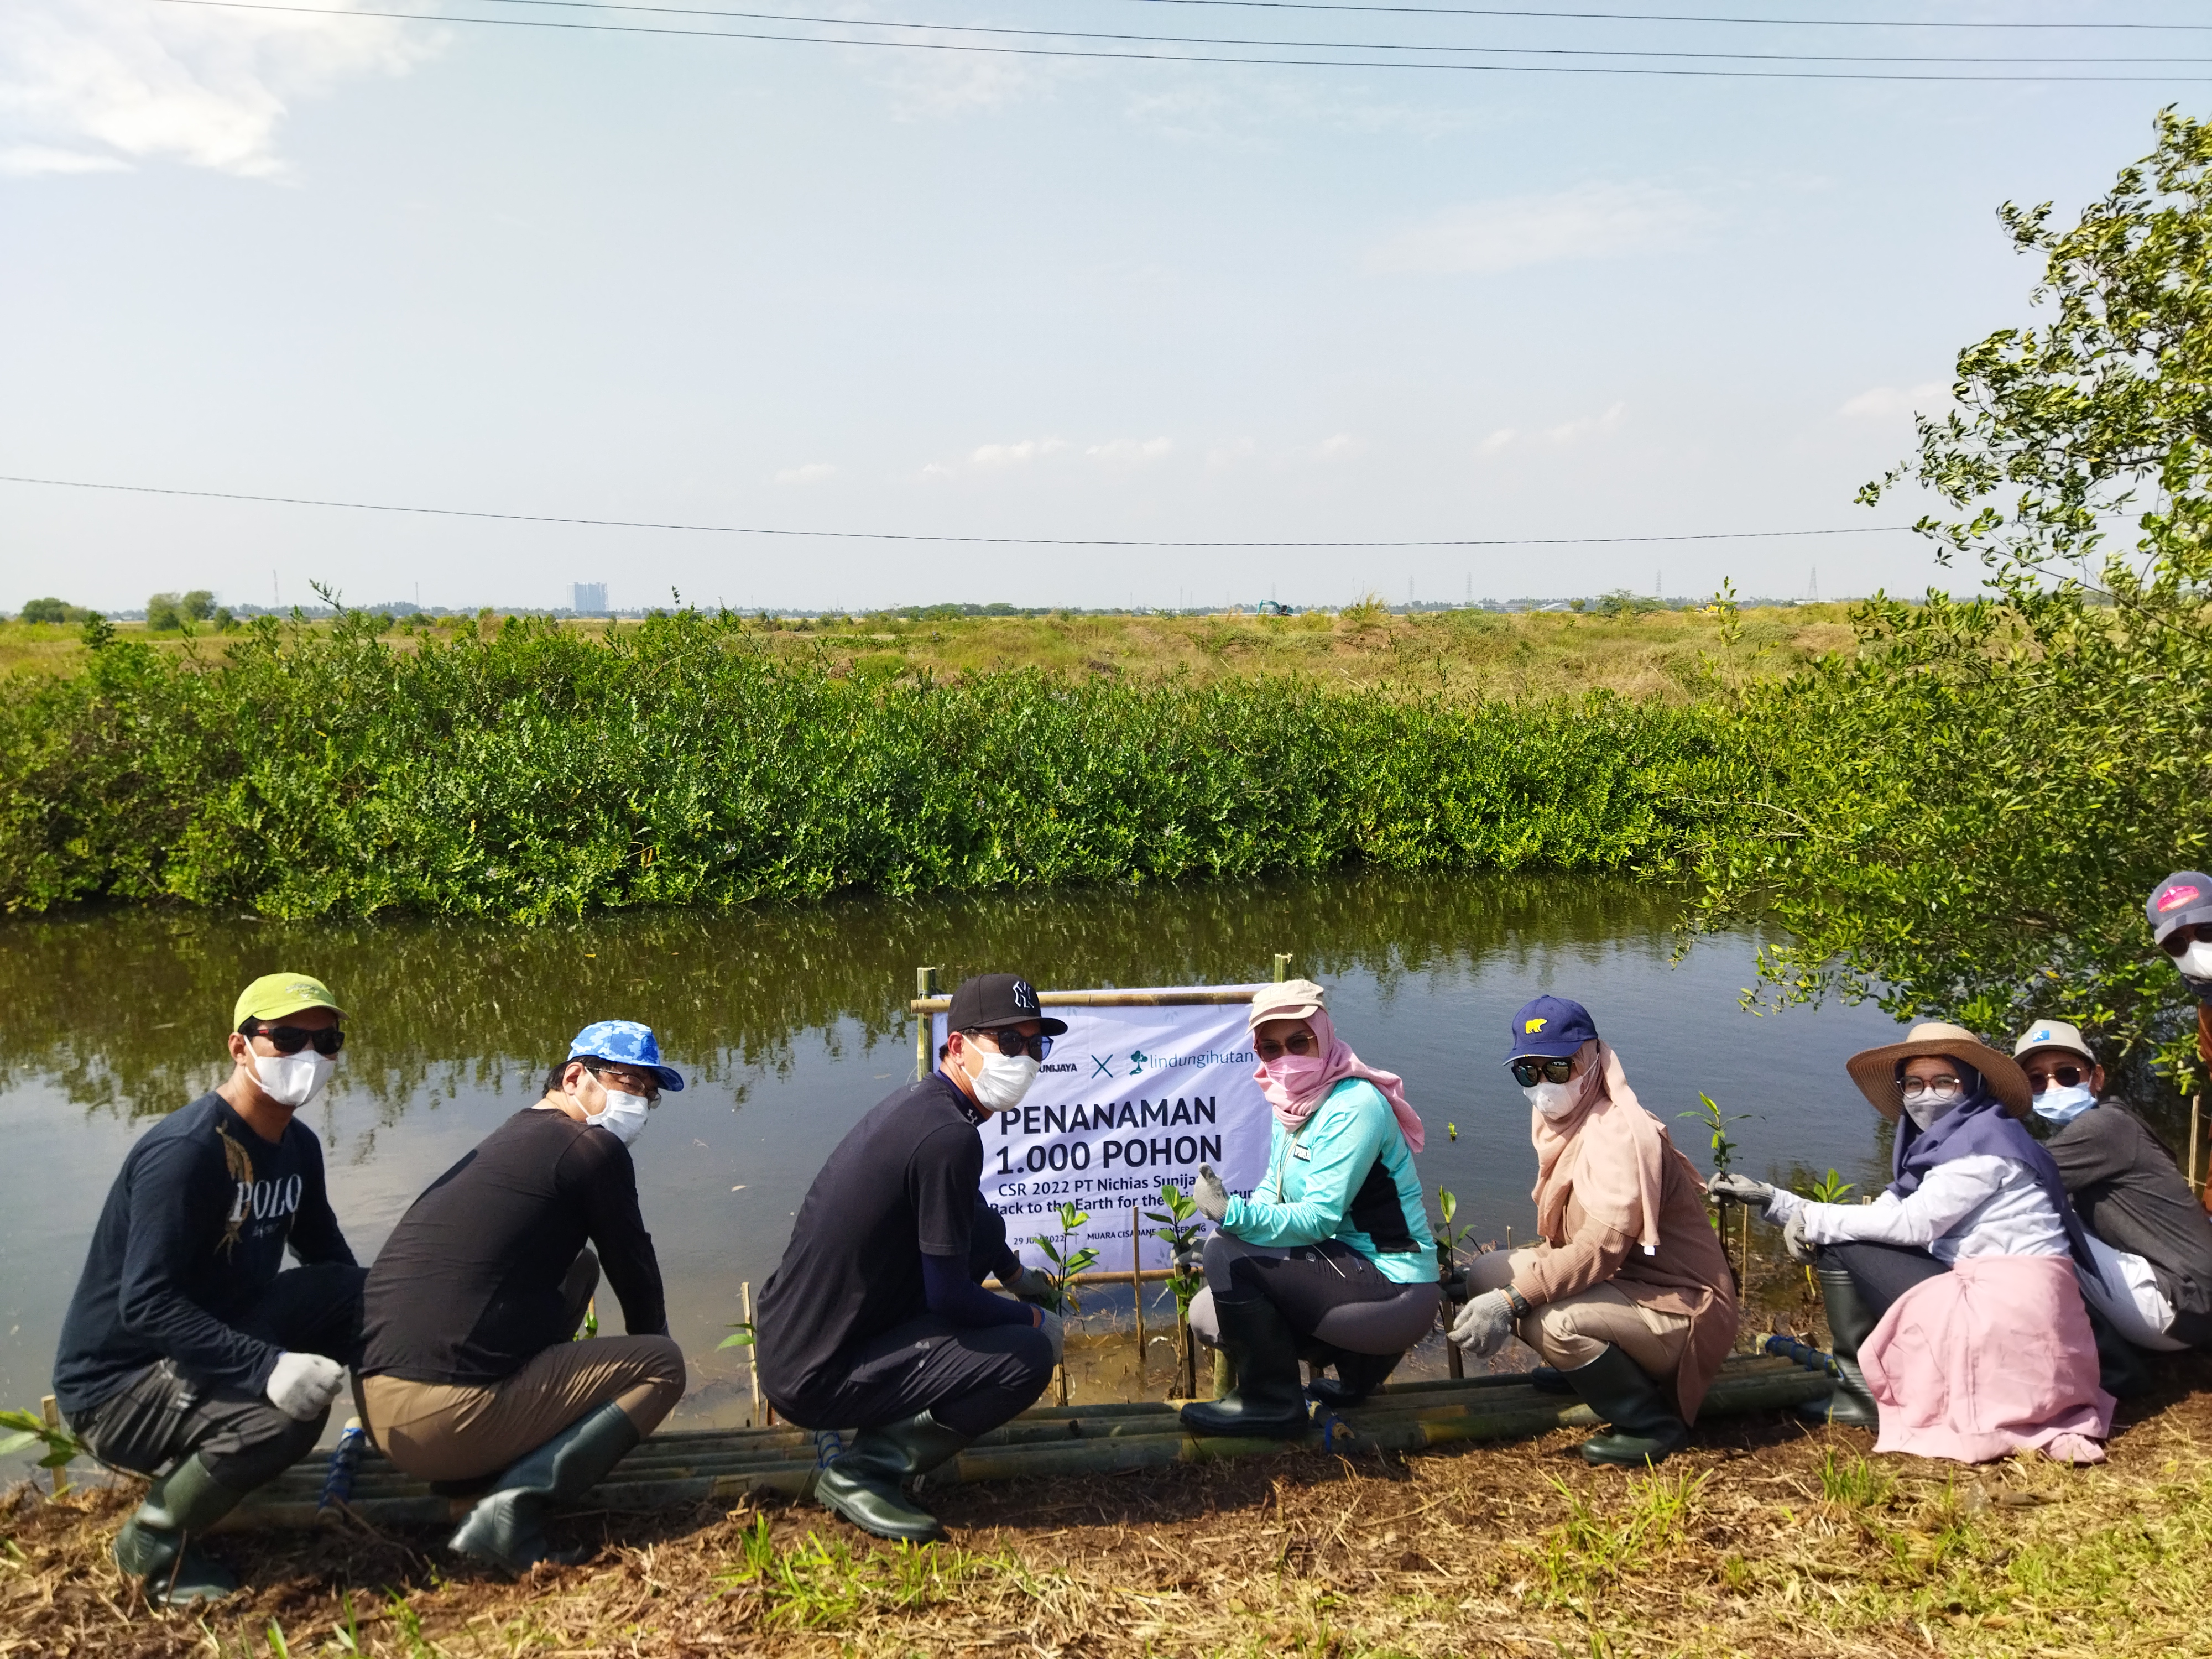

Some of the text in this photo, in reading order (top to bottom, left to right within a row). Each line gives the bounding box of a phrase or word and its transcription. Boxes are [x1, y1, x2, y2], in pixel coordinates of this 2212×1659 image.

[1012, 980, 1034, 1008] NY
[1150, 1050, 1253, 1068] lindungihutan
[1001, 1097, 1216, 1135] PENANAMAN
[996, 1135, 1222, 1175] 1.000 POHON
[229, 1173, 302, 1222] POLO
[998, 1183, 1027, 1197] CSR
[1032, 1180, 1070, 1195] 2022
[1074, 1179, 1094, 1193] PT
[1097, 1177, 1149, 1191] Nichias
[1027, 1202, 1042, 1214] to
[1047, 1199, 1067, 1213] th
[1076, 1197, 1113, 1211] Earth
[1118, 1196, 1138, 1208] for
[1142, 1194, 1165, 1207] the
[1087, 1231, 1116, 1240] MUARA
